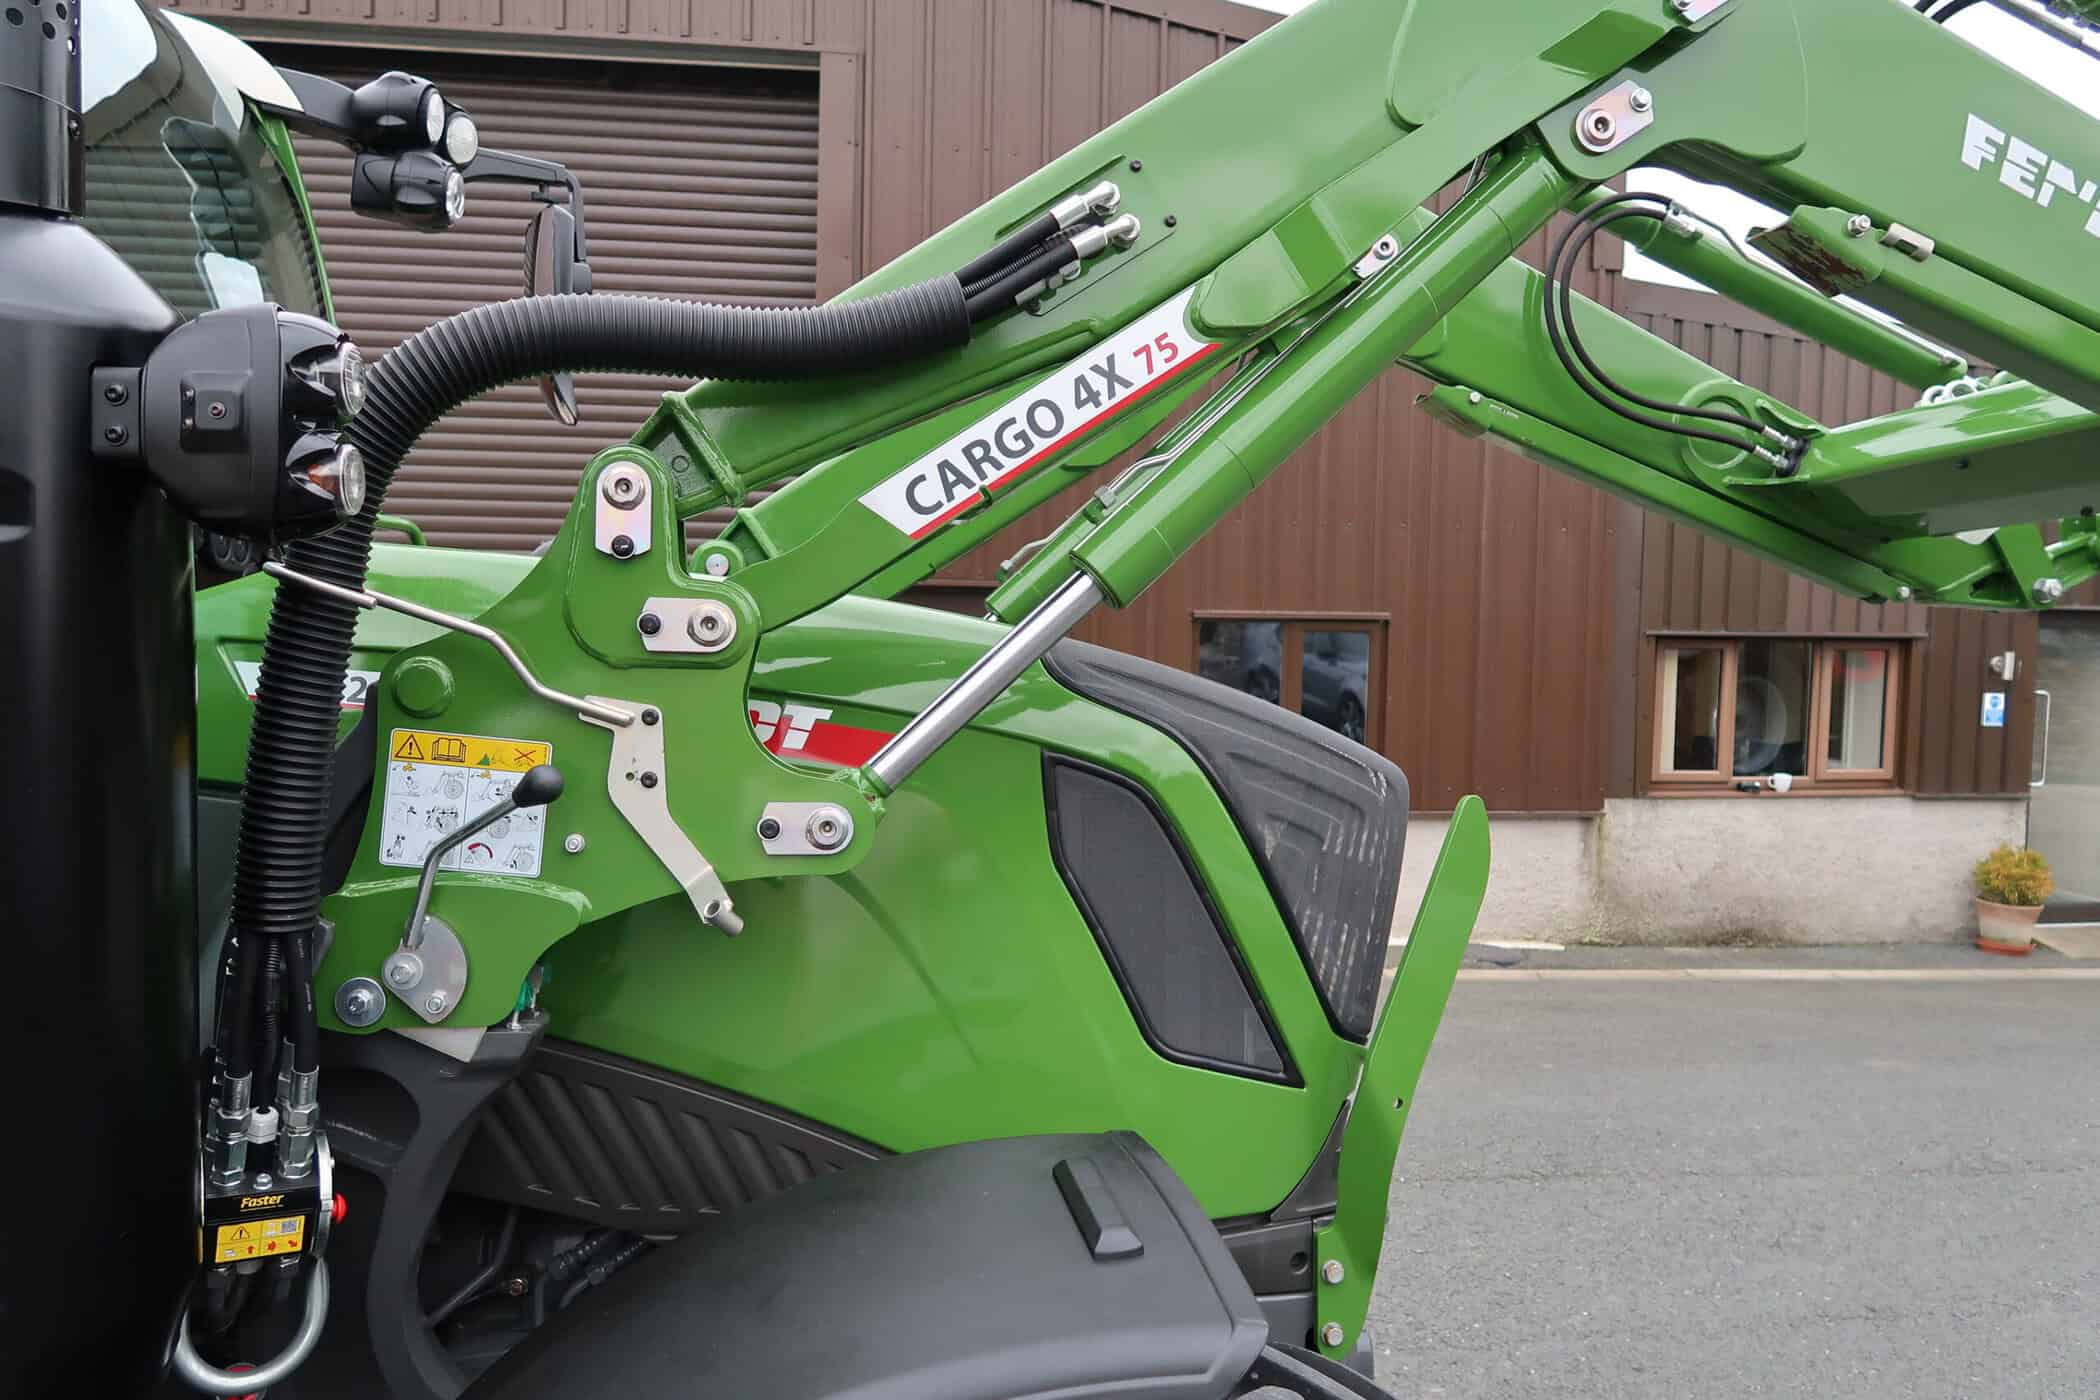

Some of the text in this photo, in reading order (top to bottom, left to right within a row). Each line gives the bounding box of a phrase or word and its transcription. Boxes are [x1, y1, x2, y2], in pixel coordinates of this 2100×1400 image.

[905, 331, 1179, 516] CARGO 4X 75
[240, 1194, 285, 1209] Faster
